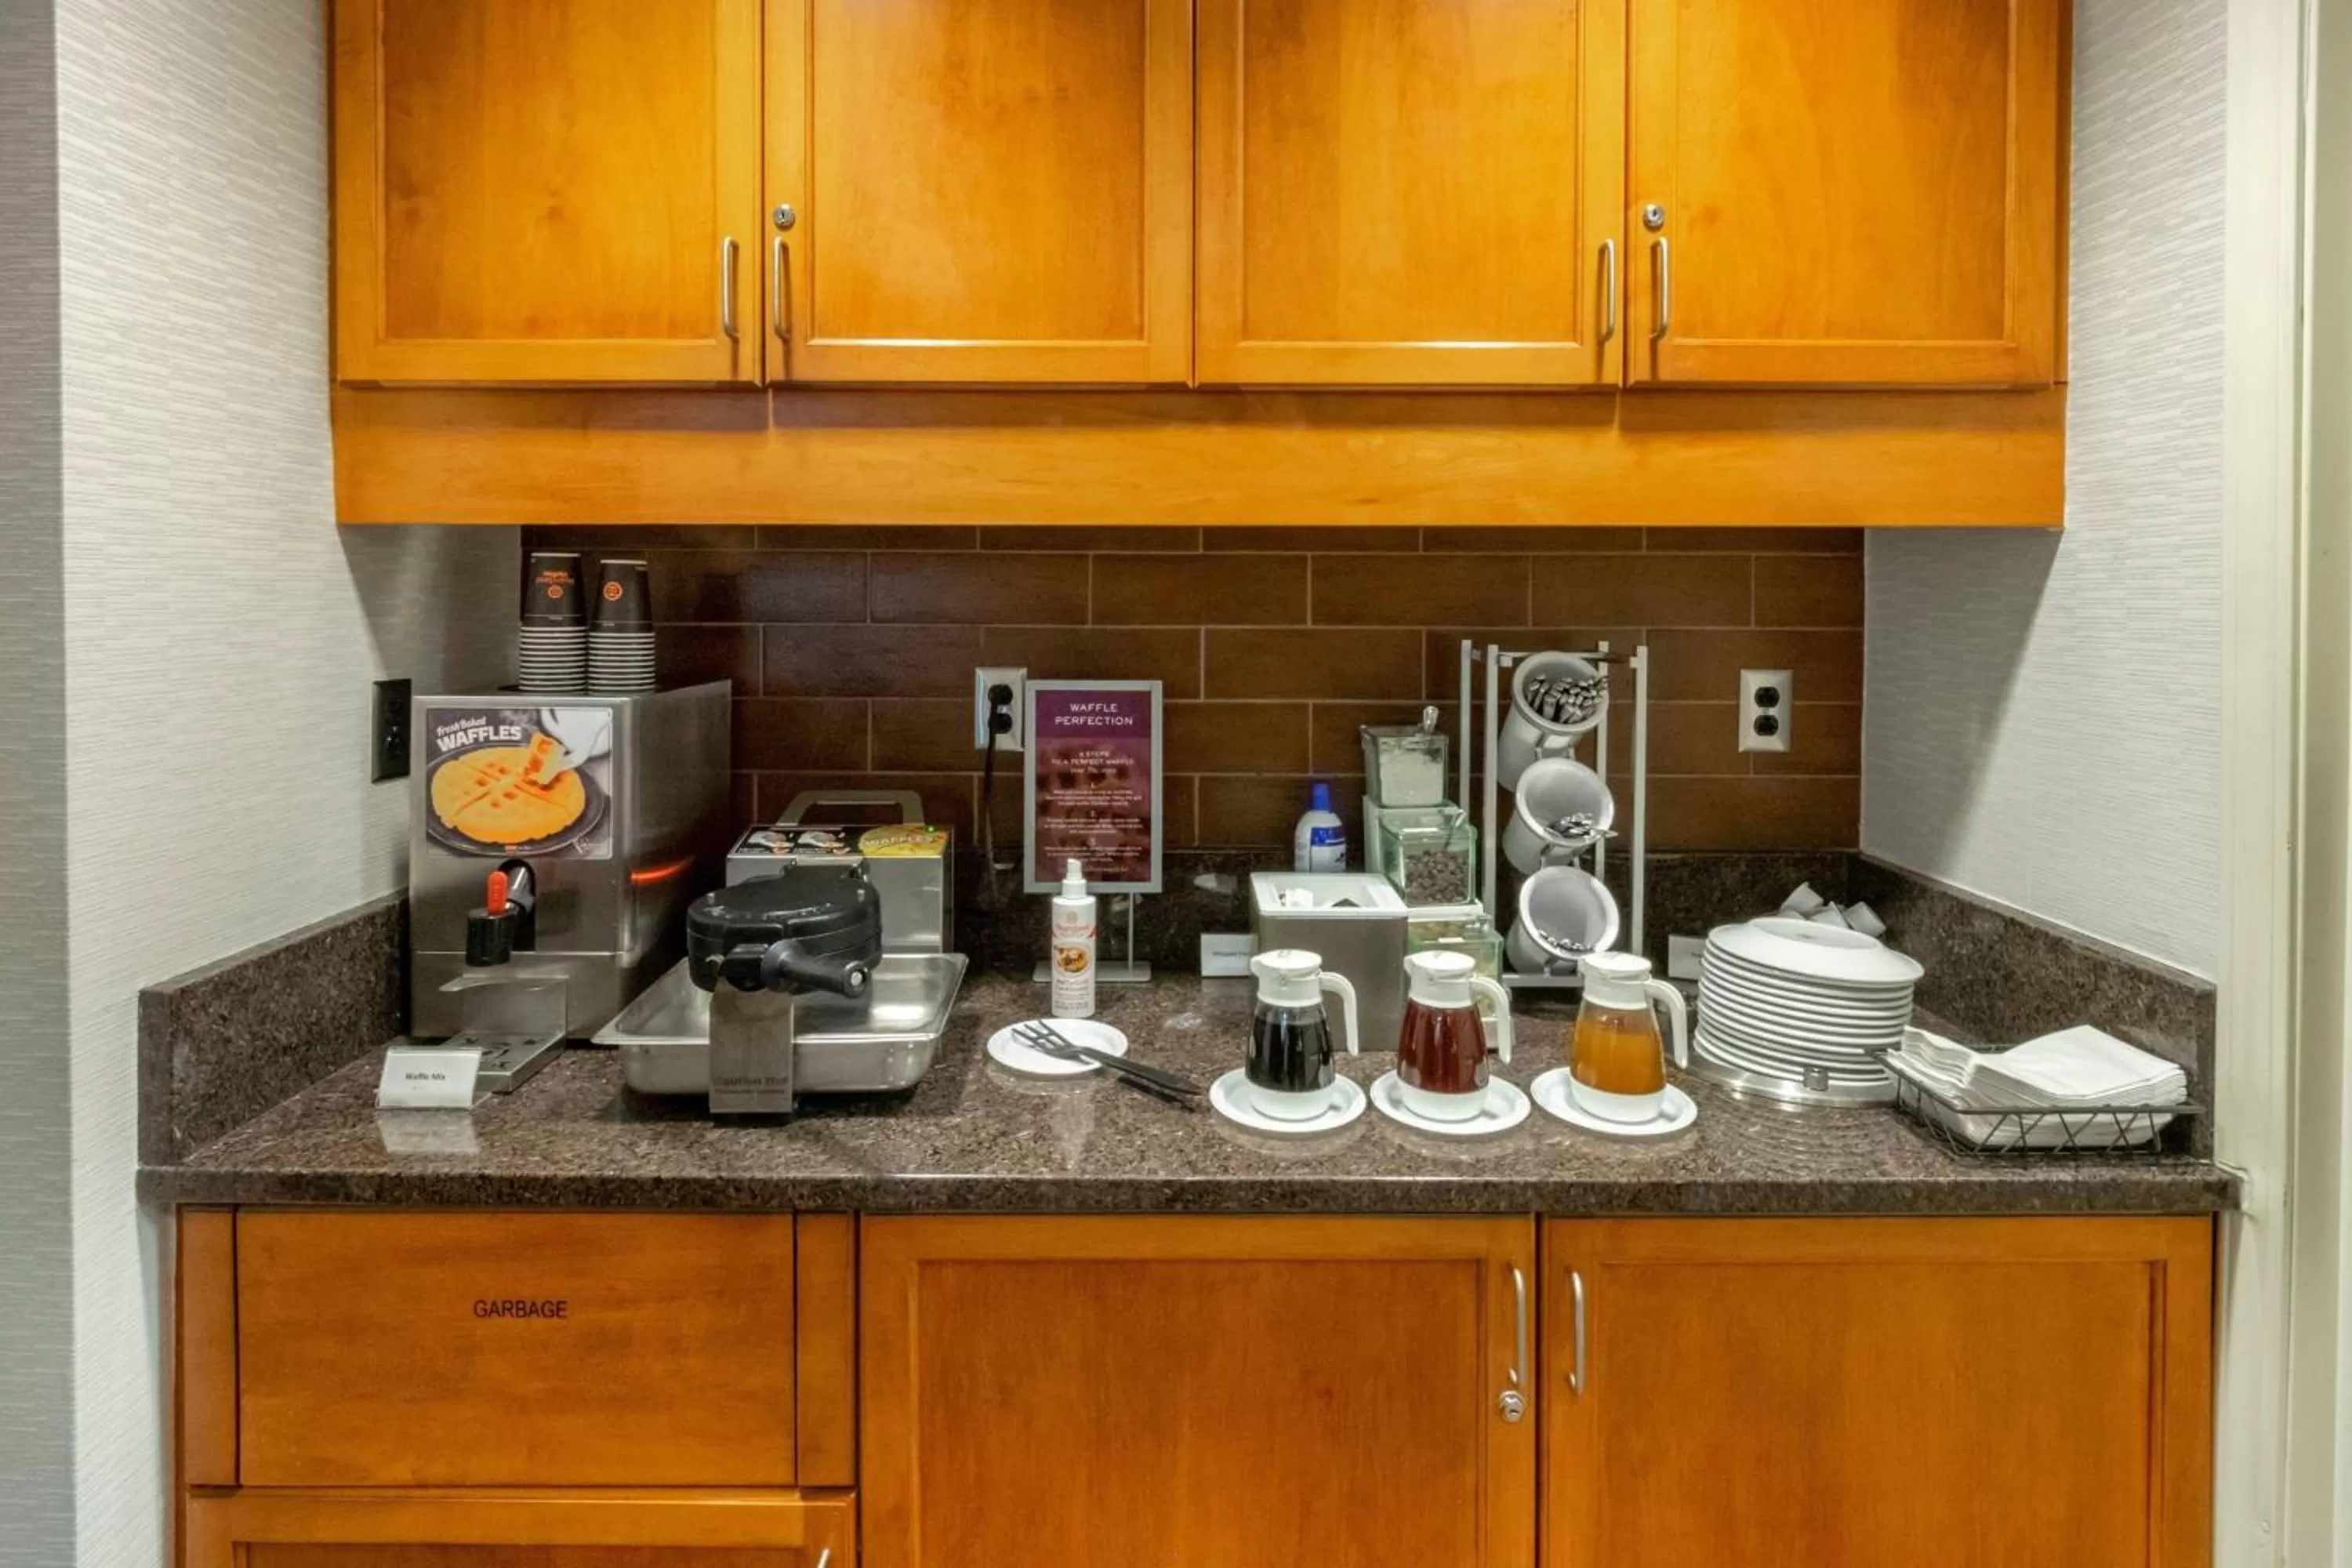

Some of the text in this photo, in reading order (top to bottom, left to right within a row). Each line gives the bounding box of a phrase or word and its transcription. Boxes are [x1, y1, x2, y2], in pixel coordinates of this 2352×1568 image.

[1069, 702, 1118, 713] WAFFLE
[1054, 716, 1134, 726] PERFECTION
[435, 725, 522, 753] WAFFLES
[473, 1299, 568, 1319] GARBAGE
